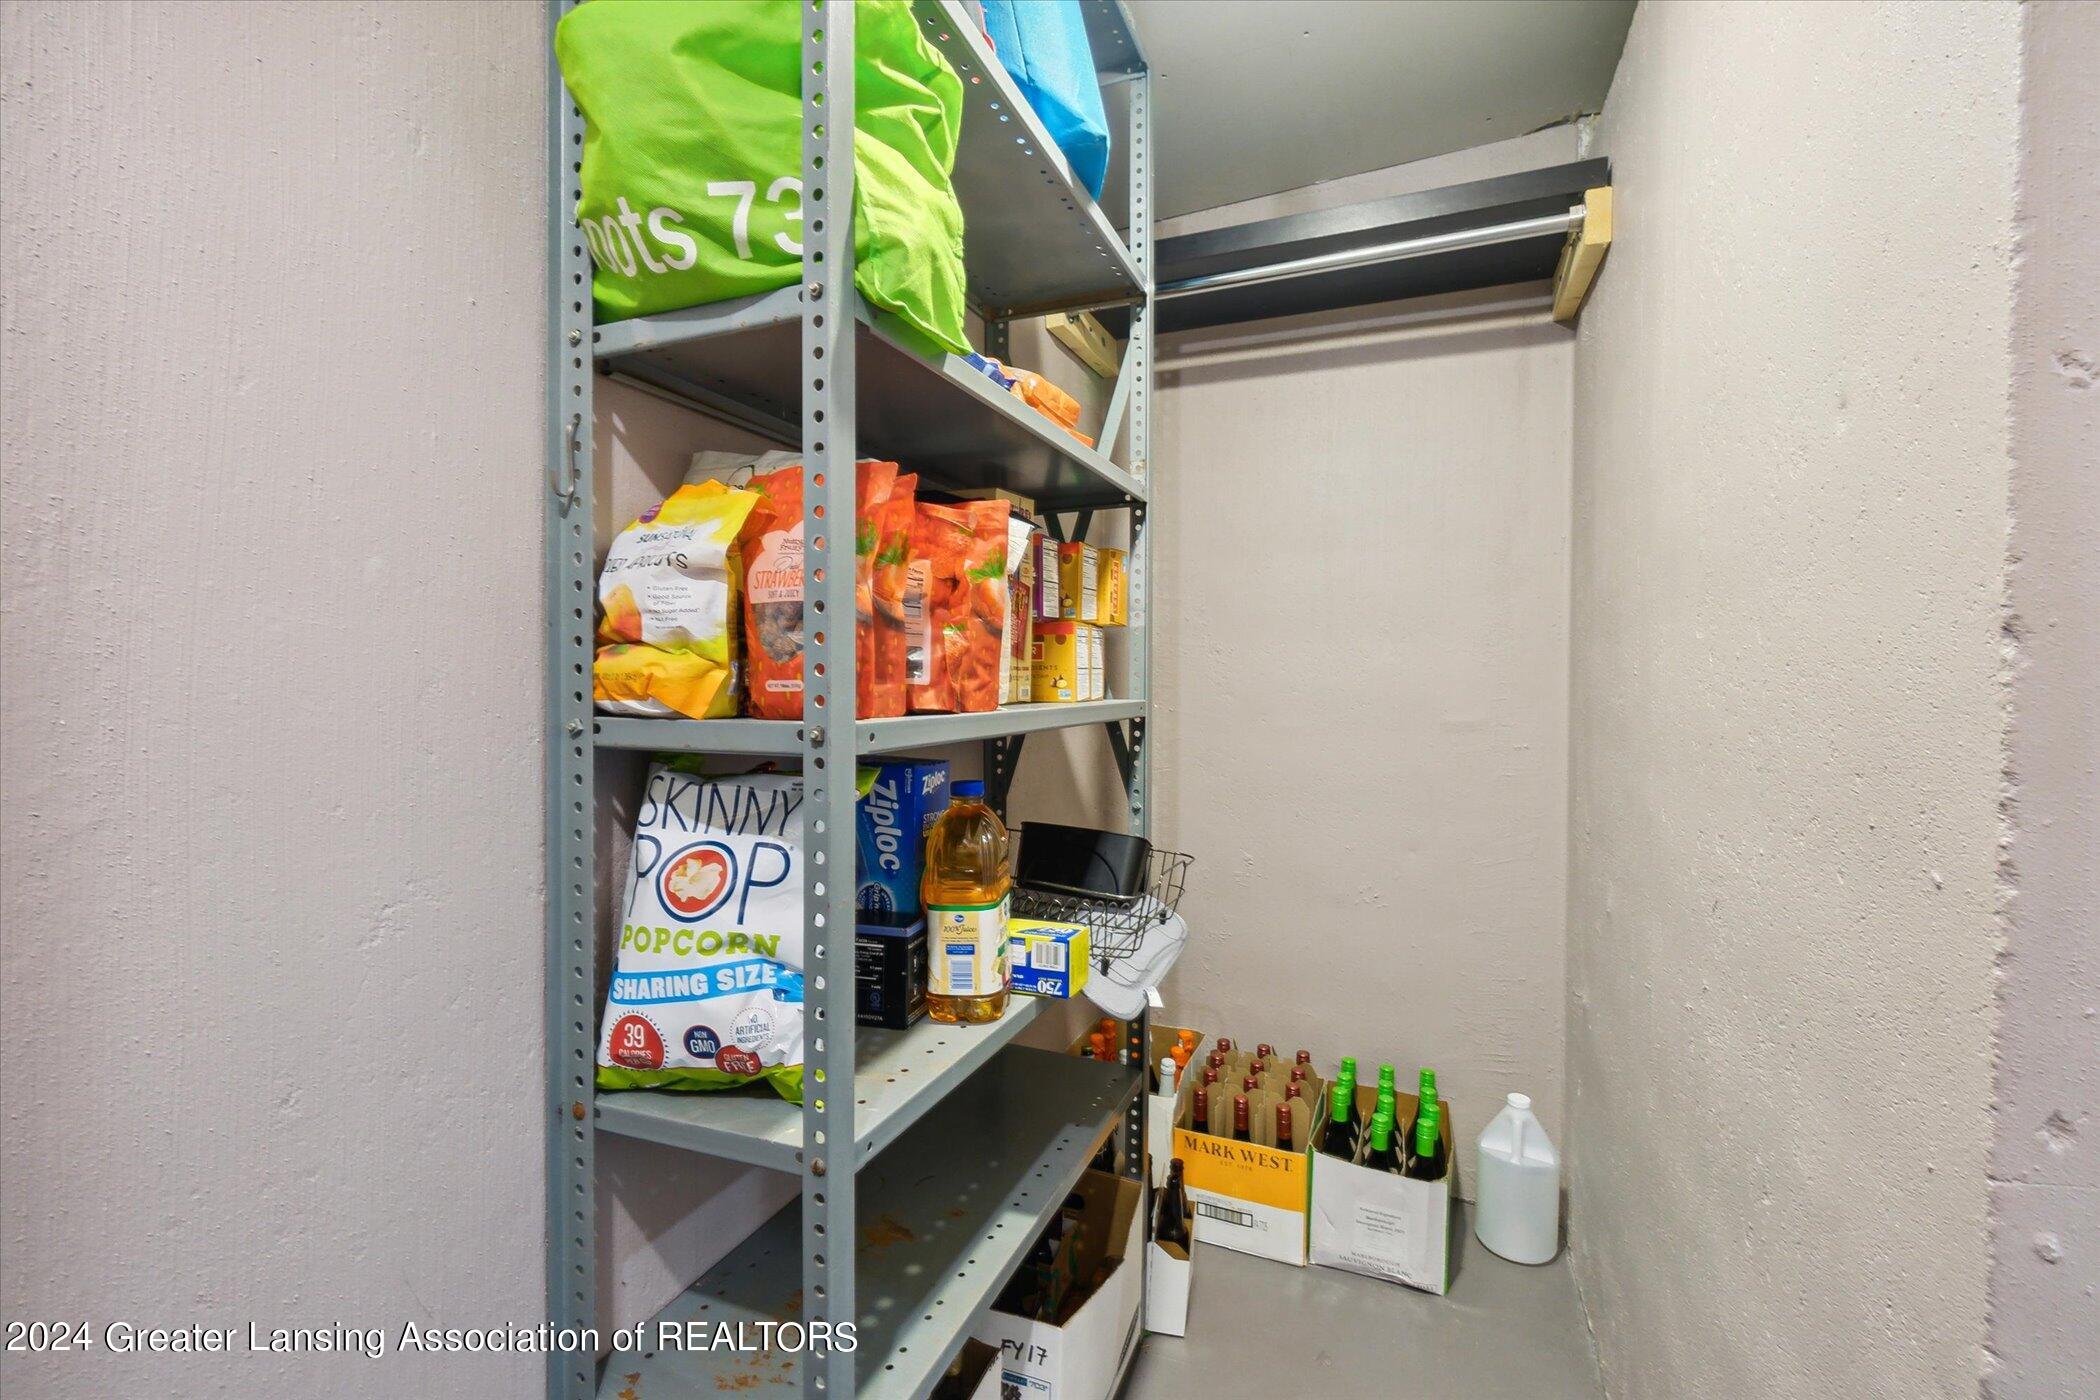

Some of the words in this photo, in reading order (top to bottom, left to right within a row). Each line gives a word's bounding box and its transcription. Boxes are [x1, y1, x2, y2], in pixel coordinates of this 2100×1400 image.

[707, 176, 804, 260] 73
[922, 769, 946, 796] Ziploc
[637, 774, 803, 837] SKINNY
[865, 779, 901, 872] Ziploc
[628, 833, 794, 925] POP
[621, 925, 781, 958] POPCORN
[613, 972, 709, 1000] SHARING
[716, 964, 778, 991] SIZE
[1037, 979, 1063, 996] 750
[624, 1023, 645, 1048] 39
[735, 1023, 770, 1036] ARTIFICIAL
[690, 1040, 716, 1053] GMO
[724, 1061, 754, 1073] FREE
[1184, 1135, 1235, 1160] MARK
[1239, 1149, 1293, 1172] WEST
